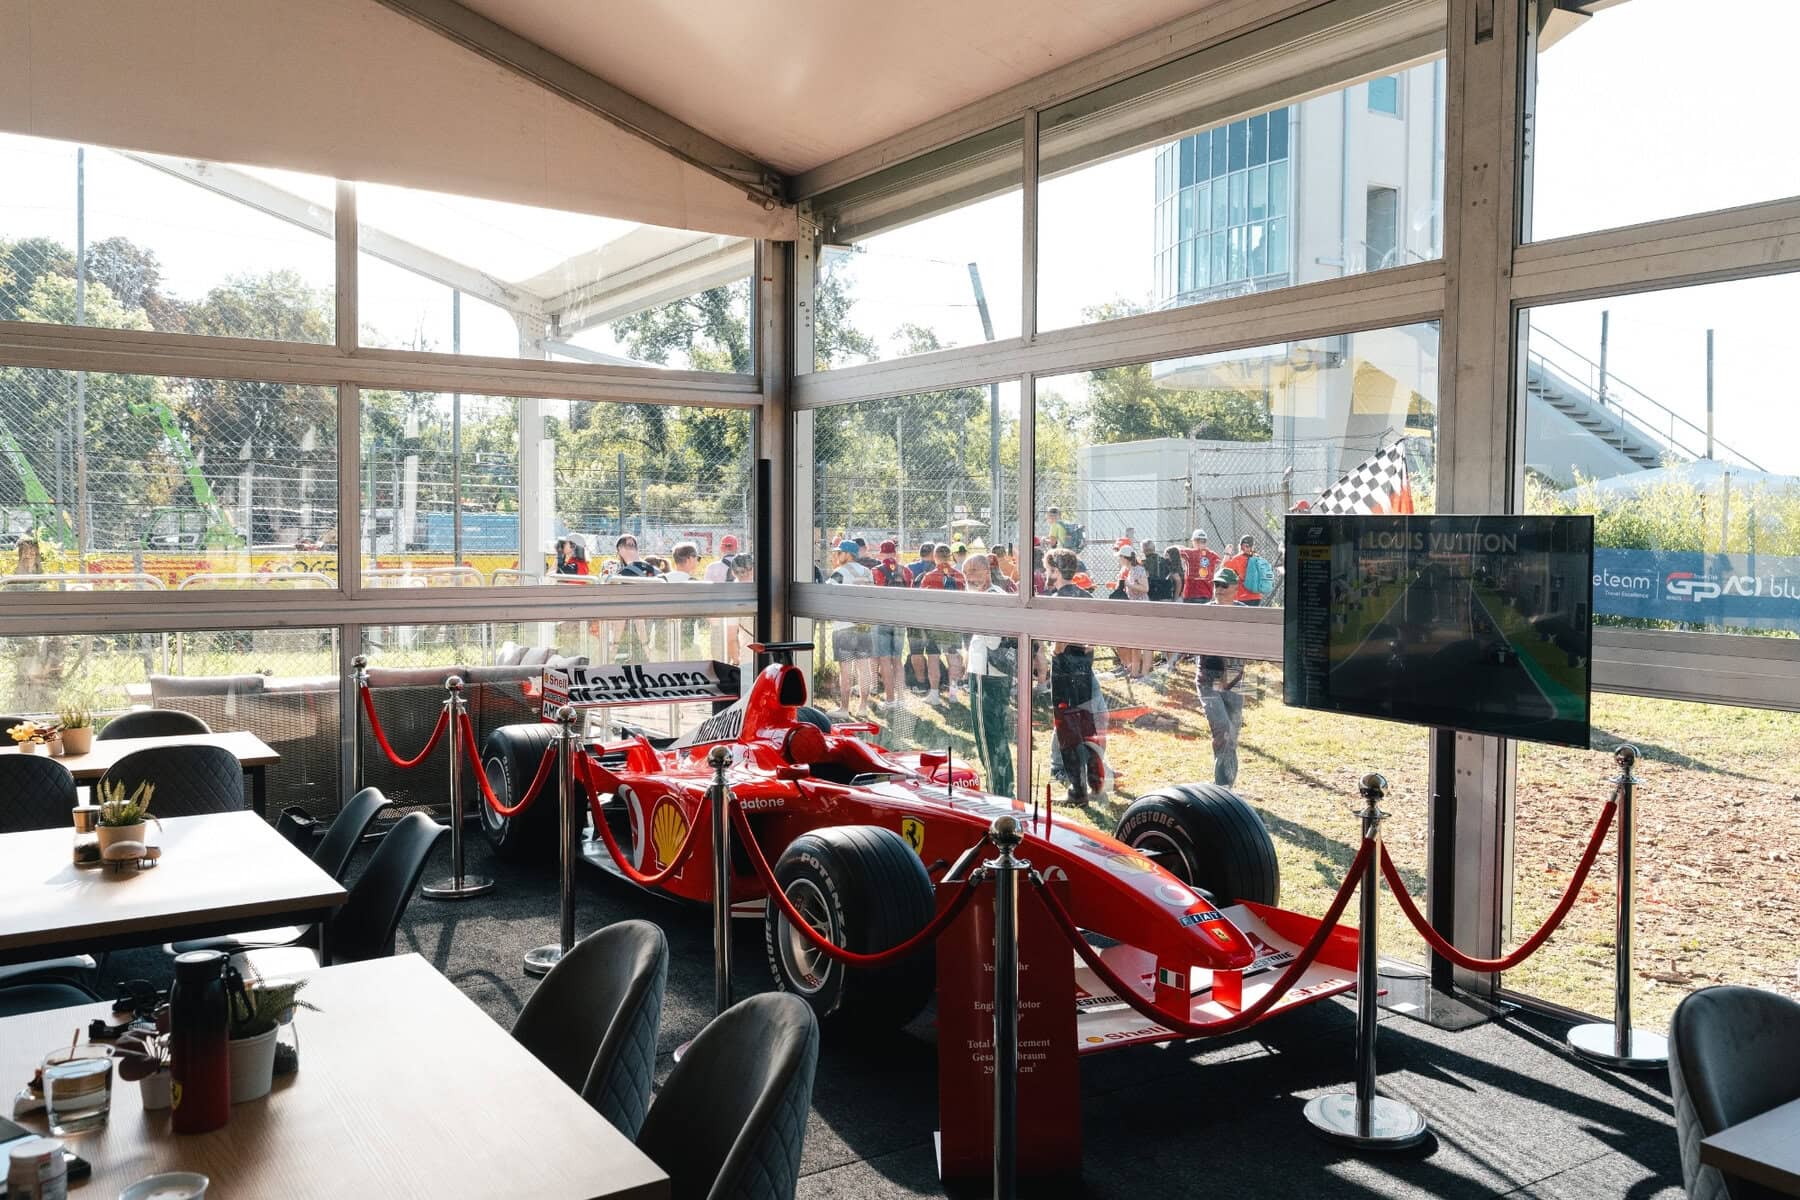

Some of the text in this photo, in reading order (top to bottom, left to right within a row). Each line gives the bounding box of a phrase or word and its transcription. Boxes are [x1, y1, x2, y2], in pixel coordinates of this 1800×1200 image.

[1369, 531, 1518, 553] LOUIS VUITTON
[549, 674, 568, 690] Shell
[568, 664, 710, 691] Marlboro
[801, 852, 846, 949] POTENZA
[1181, 910, 1221, 926] FIAT
[1104, 1026, 1169, 1040] Shell
[967, 1040, 990, 1049] Total
